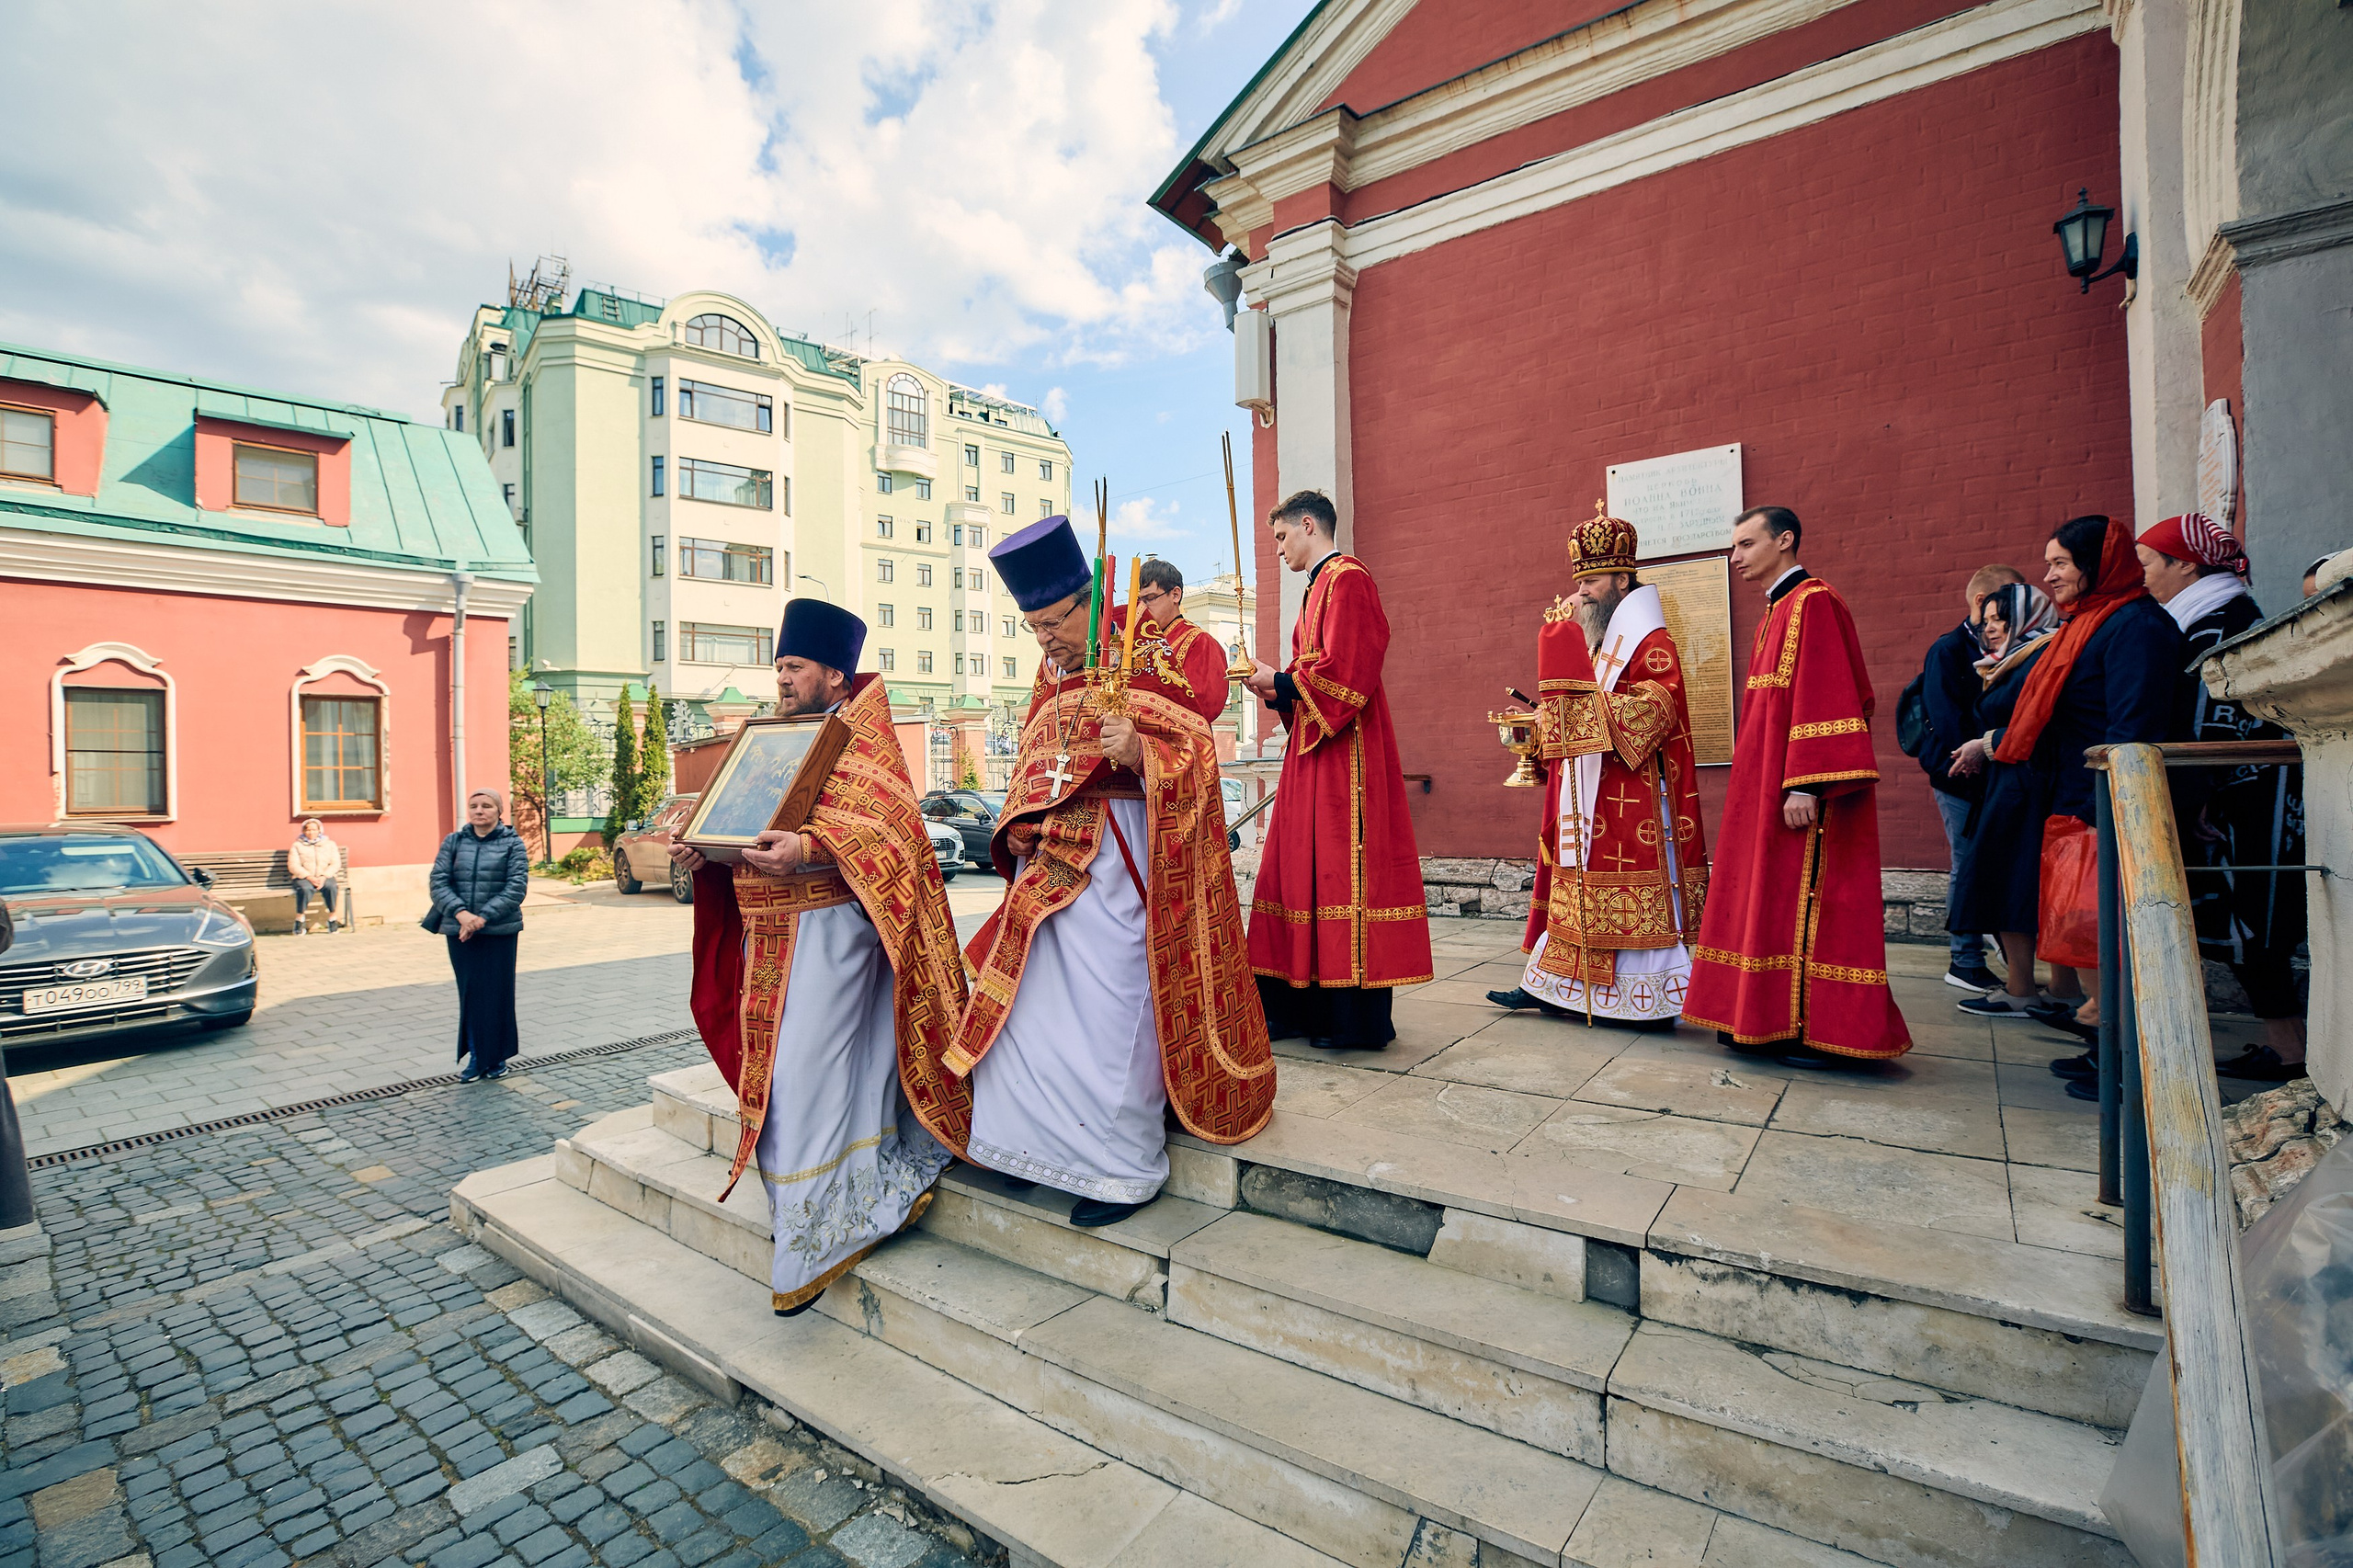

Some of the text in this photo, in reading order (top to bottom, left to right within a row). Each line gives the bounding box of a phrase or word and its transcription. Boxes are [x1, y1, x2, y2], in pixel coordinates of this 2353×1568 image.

[1624, 491, 1672, 506] ИОАННА
[1672, 528, 1733, 543] ГОСУДАРСТВОМ
[113, 979, 141, 993] 799
